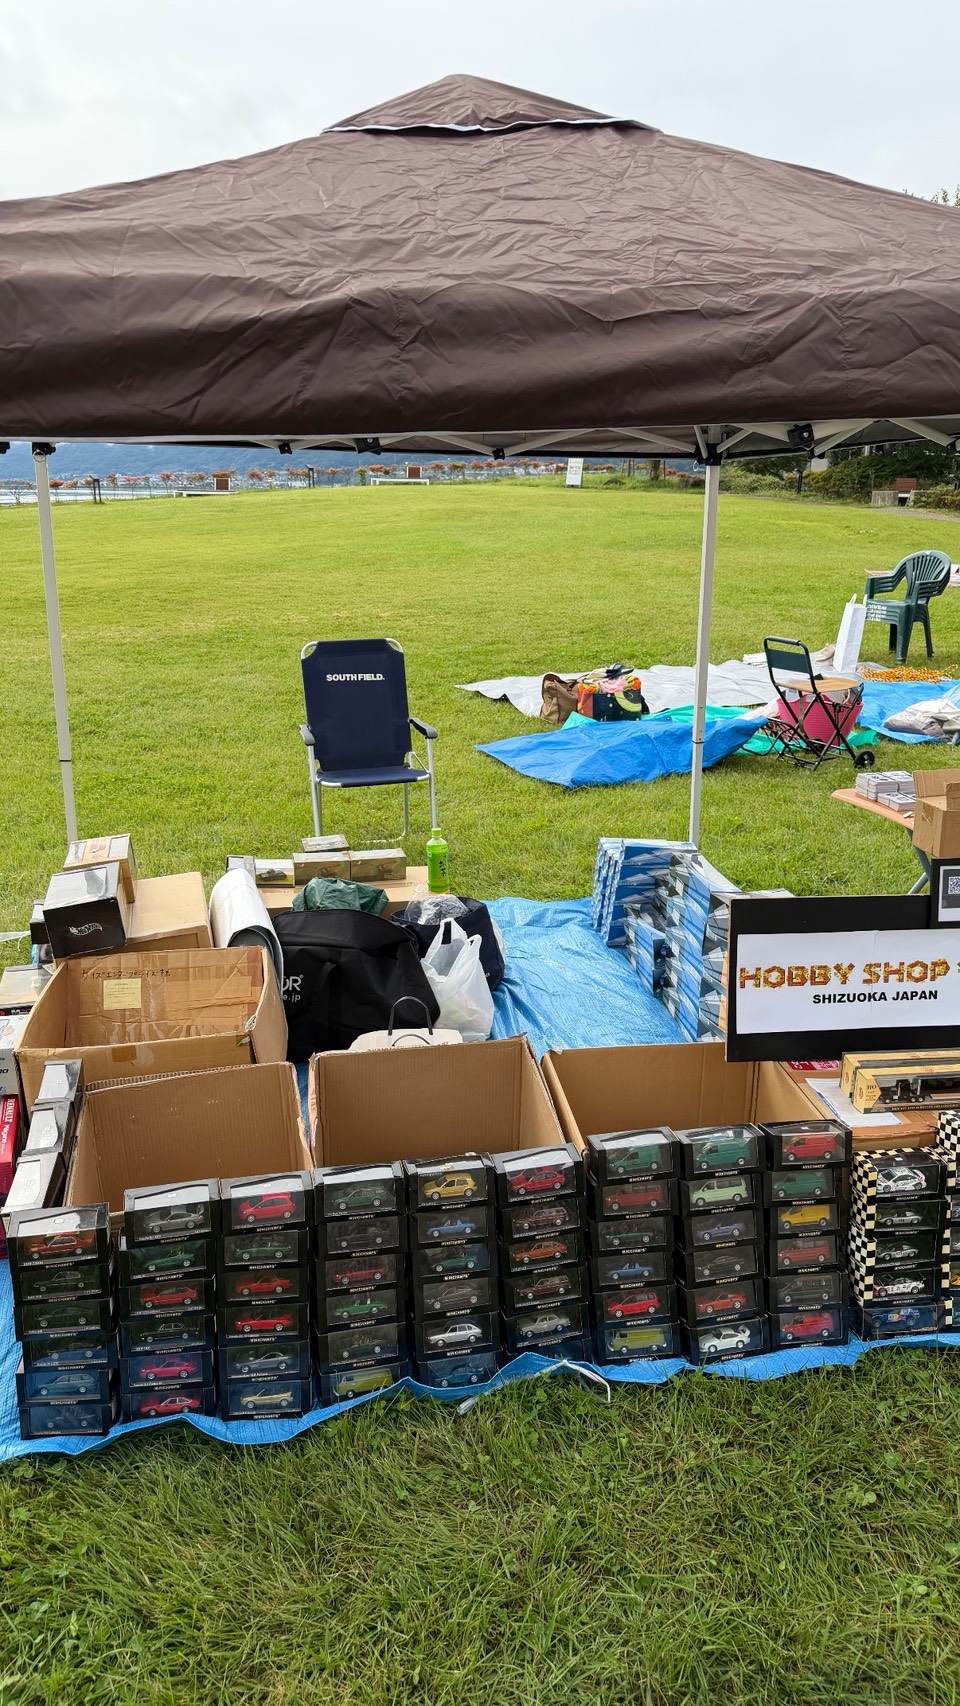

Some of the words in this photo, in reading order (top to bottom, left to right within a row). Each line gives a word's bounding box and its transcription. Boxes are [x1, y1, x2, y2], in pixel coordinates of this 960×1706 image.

[739, 962, 856, 989] HOBBY
[862, 958, 950, 985] SHOP
[812, 991, 888, 1005] SHIZUOKA
[892, 990, 938, 1001] JAPAN
[5, 1098, 16, 1123] RENAULT
